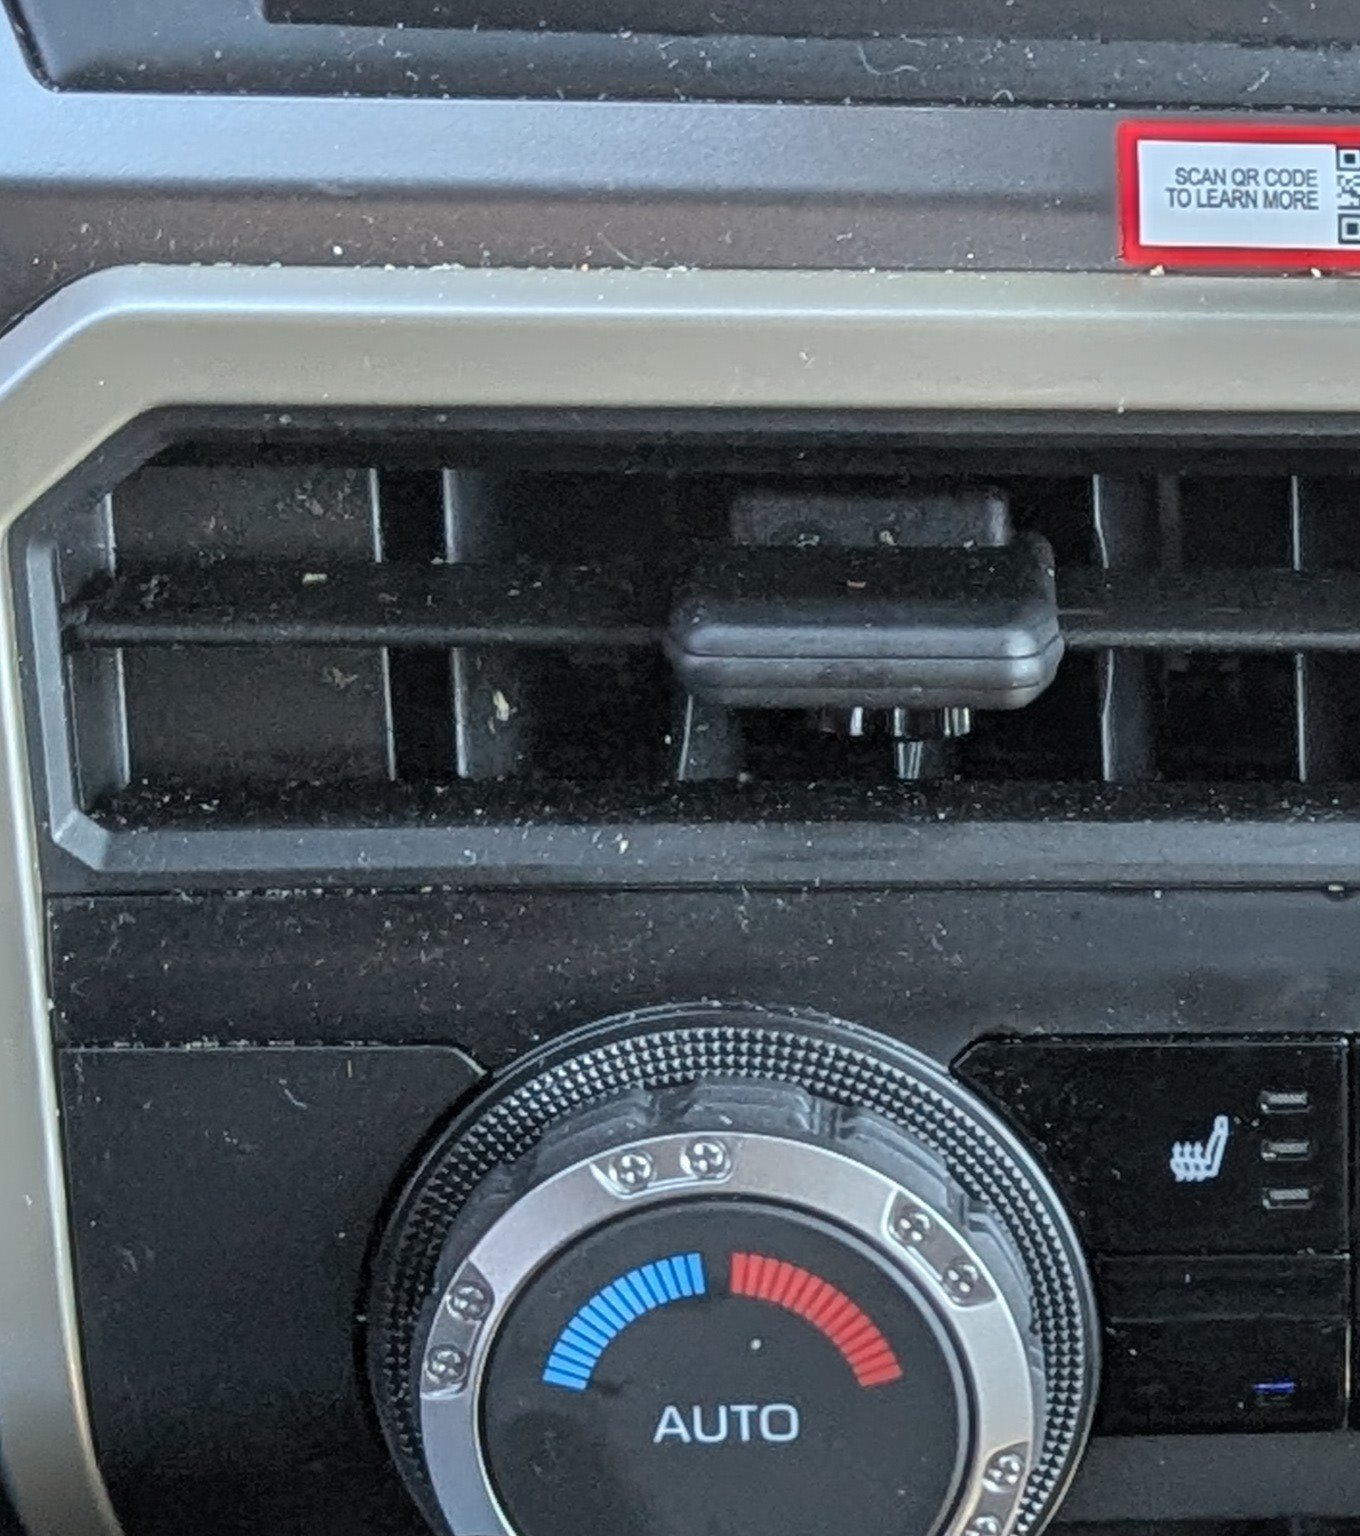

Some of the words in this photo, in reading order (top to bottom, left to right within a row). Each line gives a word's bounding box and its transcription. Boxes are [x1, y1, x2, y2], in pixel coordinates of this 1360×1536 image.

[1175, 167, 1226, 187] SCAN
[1231, 168, 1260, 188] QR
[1264, 169, 1318, 188] CODE
[1165, 187, 1192, 208] TO
[1197, 188, 1258, 209] LEARN
[1263, 190, 1319, 210] MORE
[653, 1403, 799, 1443] AUTO
